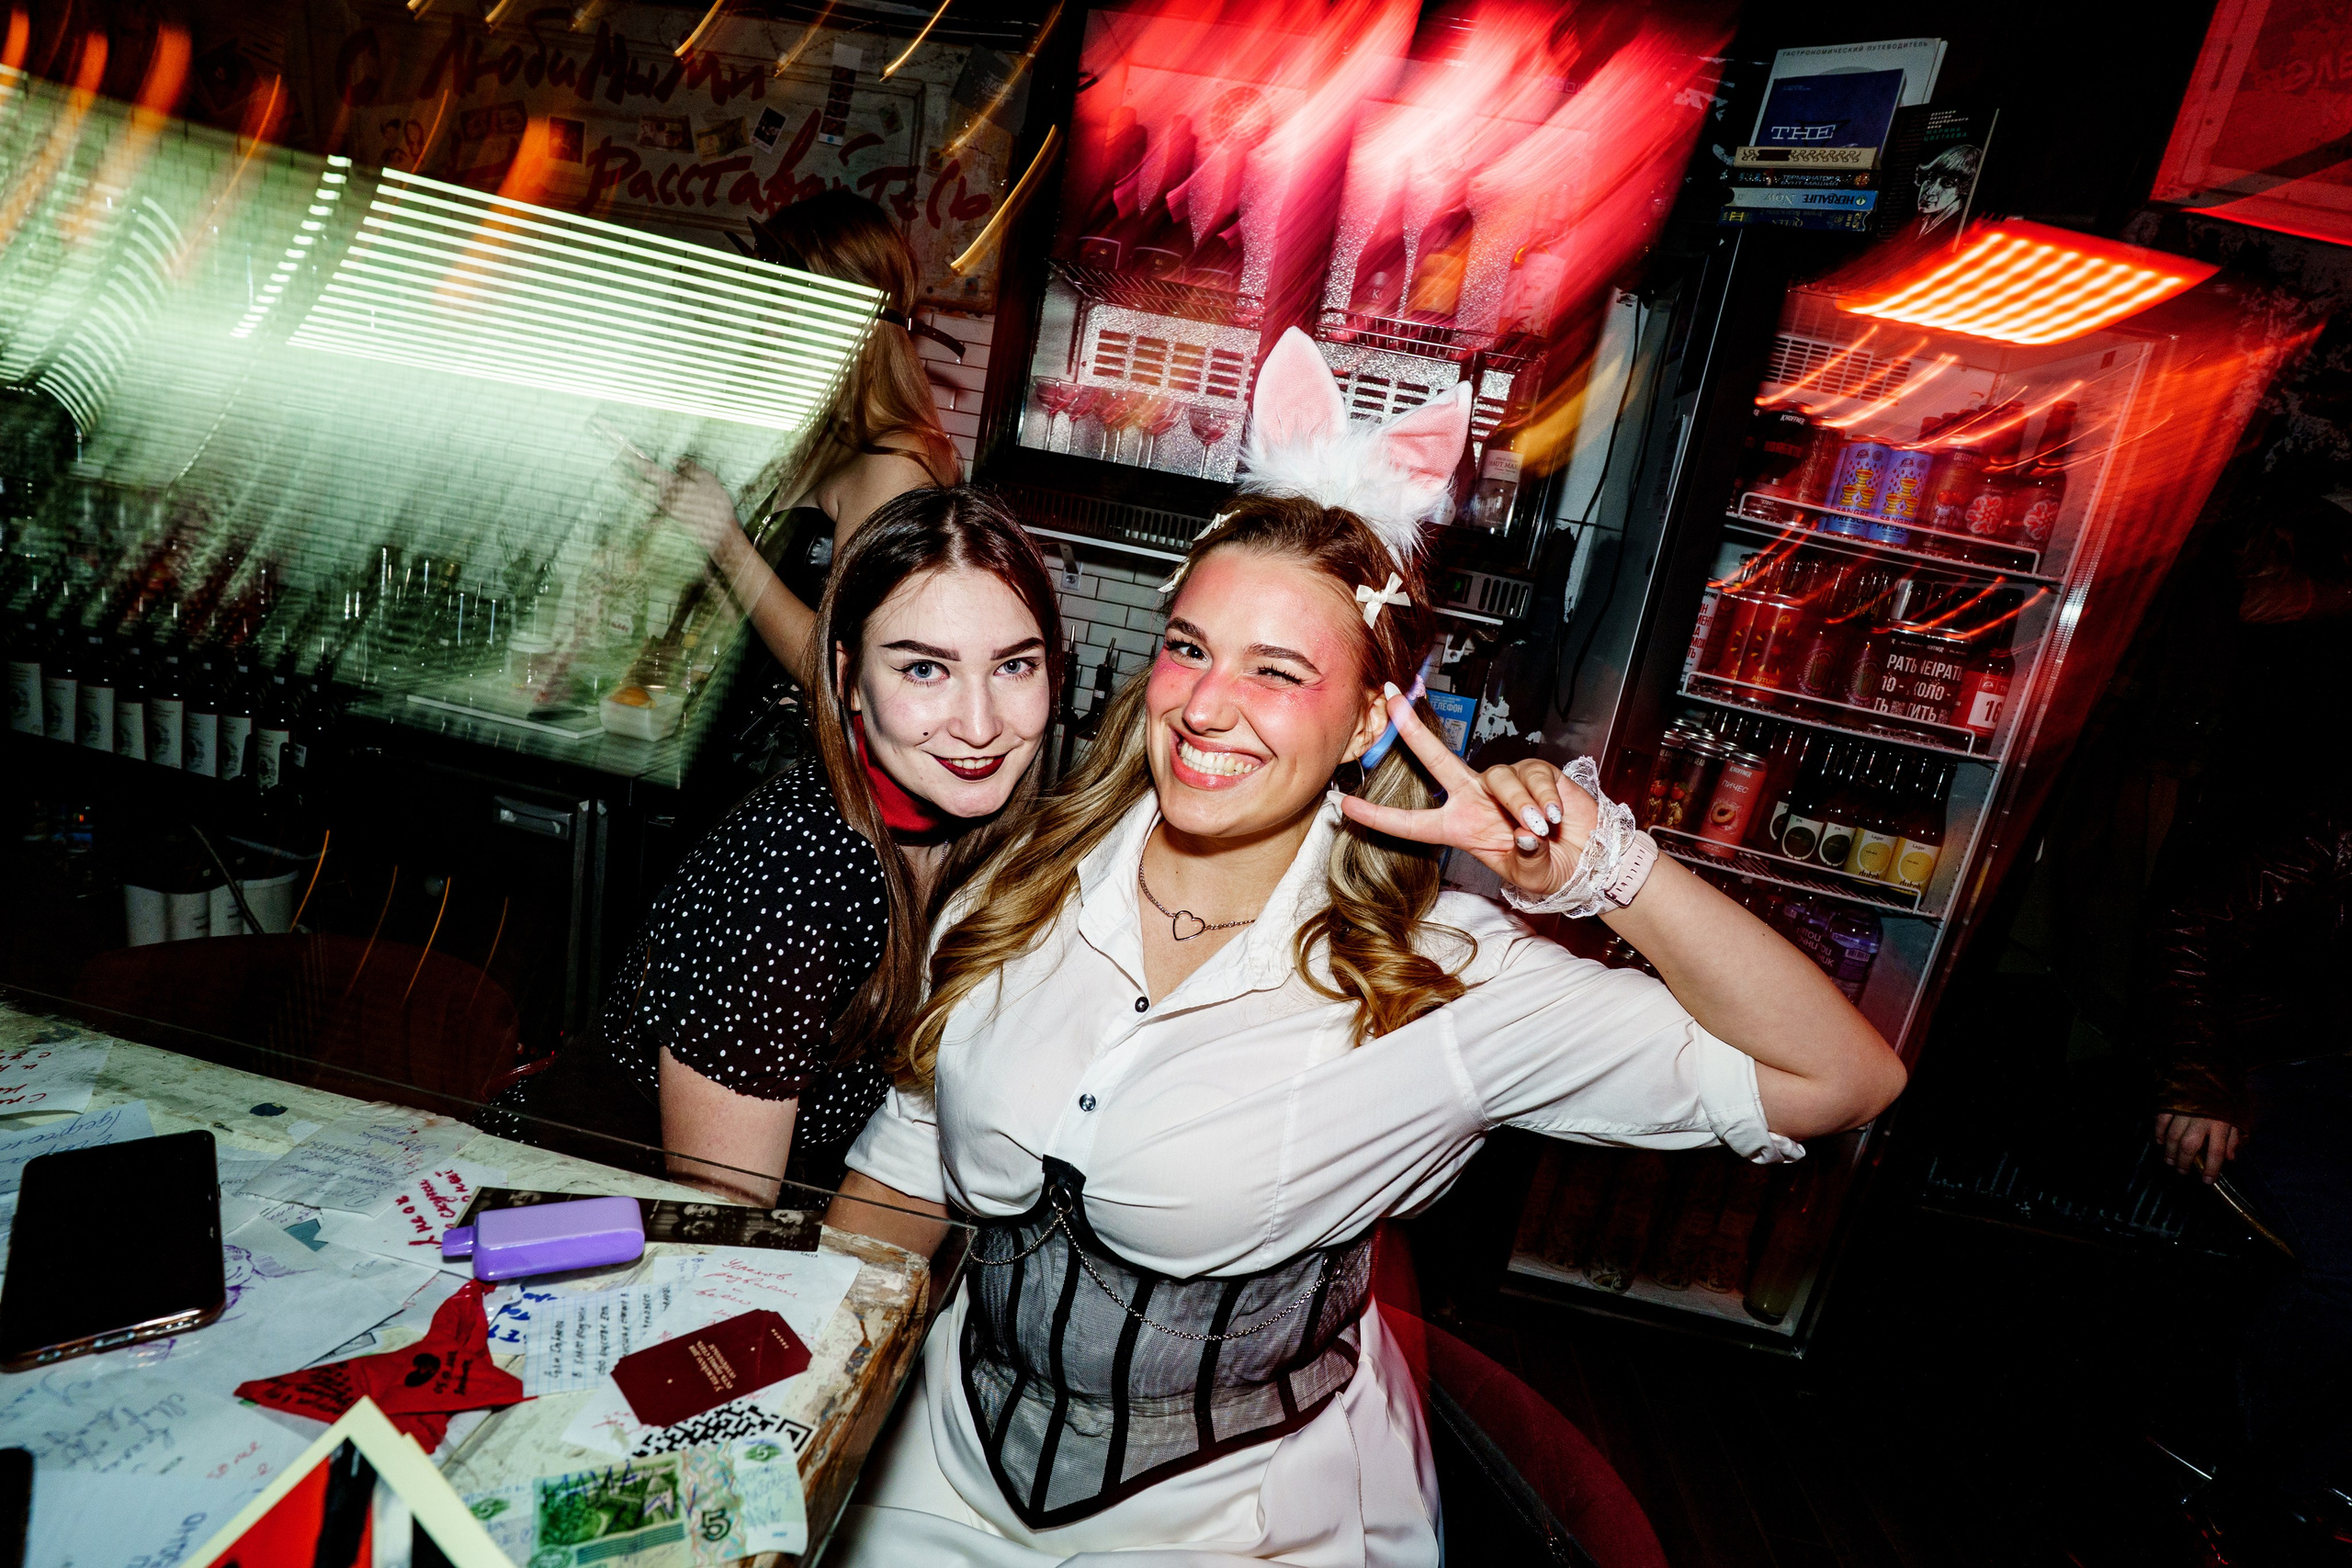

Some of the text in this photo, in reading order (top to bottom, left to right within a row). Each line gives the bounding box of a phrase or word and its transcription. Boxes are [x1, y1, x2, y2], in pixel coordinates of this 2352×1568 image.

[1782, 41, 1929, 57] ГАСТРОНОМИЧЕСКИЙ ПУТЕВОДИТЕЛЬ
[1770, 125, 1837, 140] THE
[1923, 132, 1967, 141] ЦВЕТАЕВА
[1926, 127, 1962, 135] МАРИНА
[1803, 194, 1855, 205] HERBALIFE
[1772, 216, 1804, 228] QUEEN
[1836, 506, 1871, 518] SANGRE
[1880, 515, 1913, 526] SANGRE
[1430, 701, 1464, 714] ТЕЛЕФОН
[701, 1507, 732, 1542] 5
